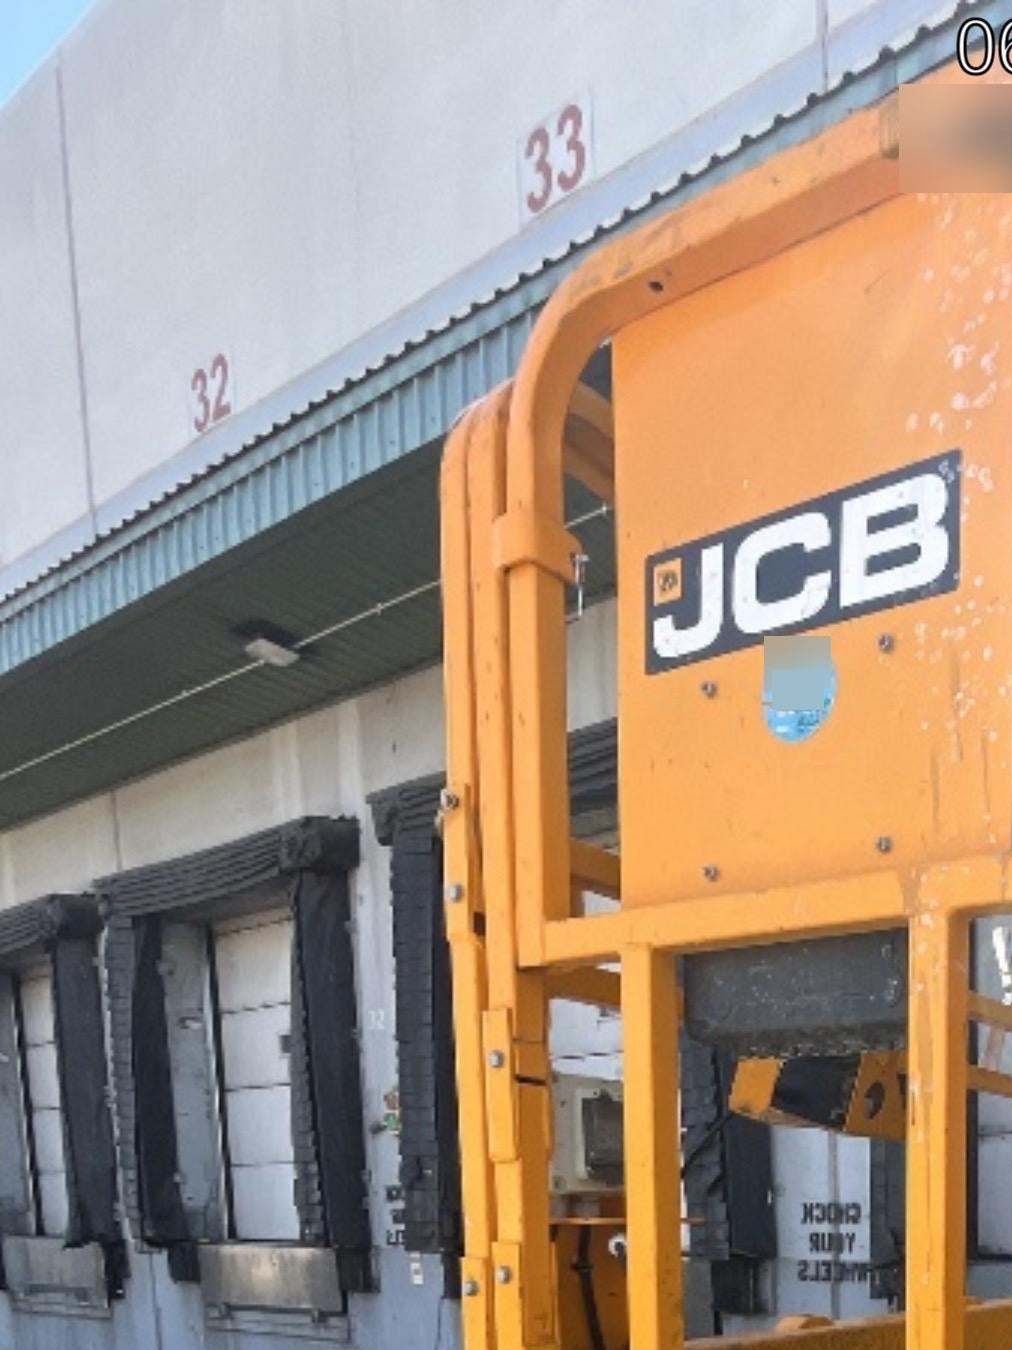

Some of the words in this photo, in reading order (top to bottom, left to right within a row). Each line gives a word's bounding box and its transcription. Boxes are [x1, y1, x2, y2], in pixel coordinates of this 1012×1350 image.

[525, 103, 586, 214] 33
[191, 353, 232, 433] 32
[653, 473, 950, 658] JCB
